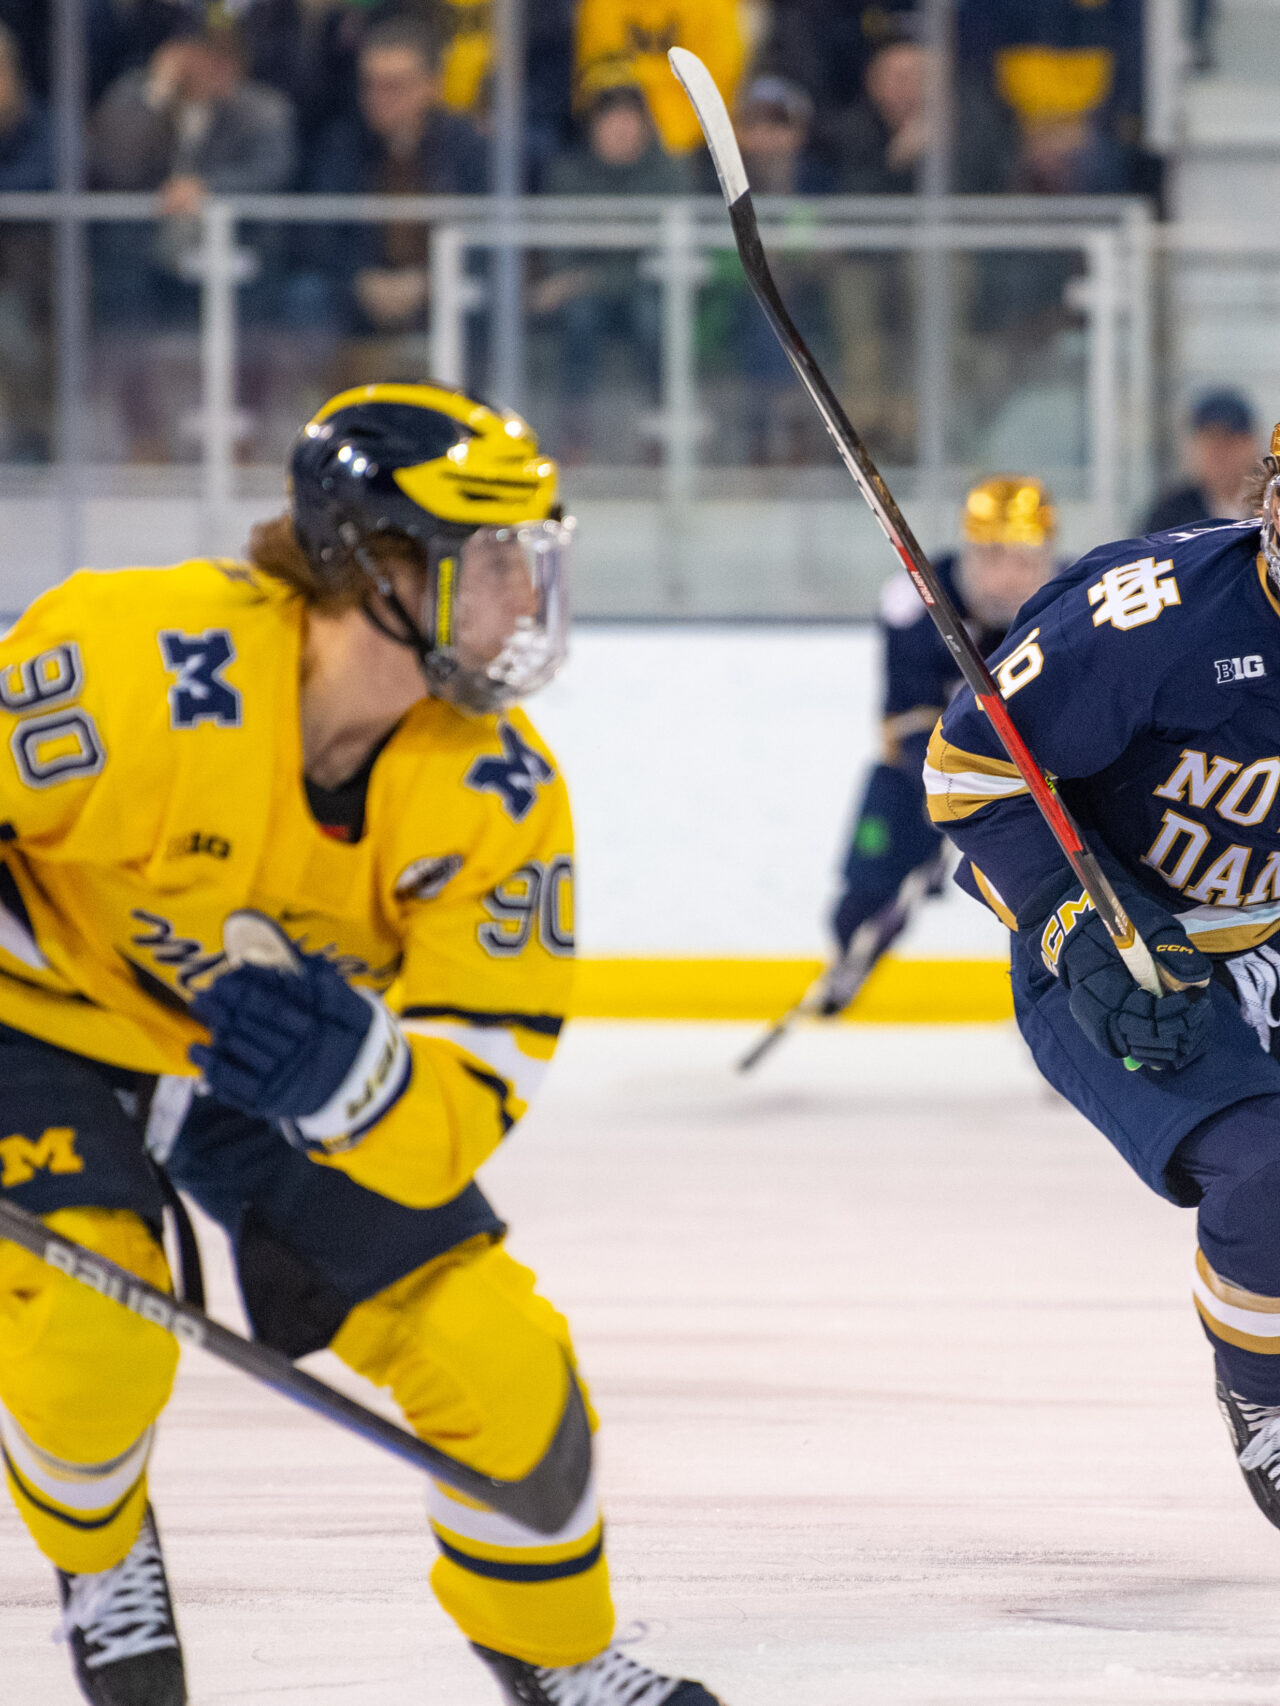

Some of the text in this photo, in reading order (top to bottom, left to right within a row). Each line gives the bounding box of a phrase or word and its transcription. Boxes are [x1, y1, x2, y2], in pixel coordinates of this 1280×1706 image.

[0, 641, 107, 790] 90
[157, 628, 243, 730] M
[463, 719, 555, 824] M
[1156, 944, 1195, 955] CCM
[0, 1126, 85, 1188] M
